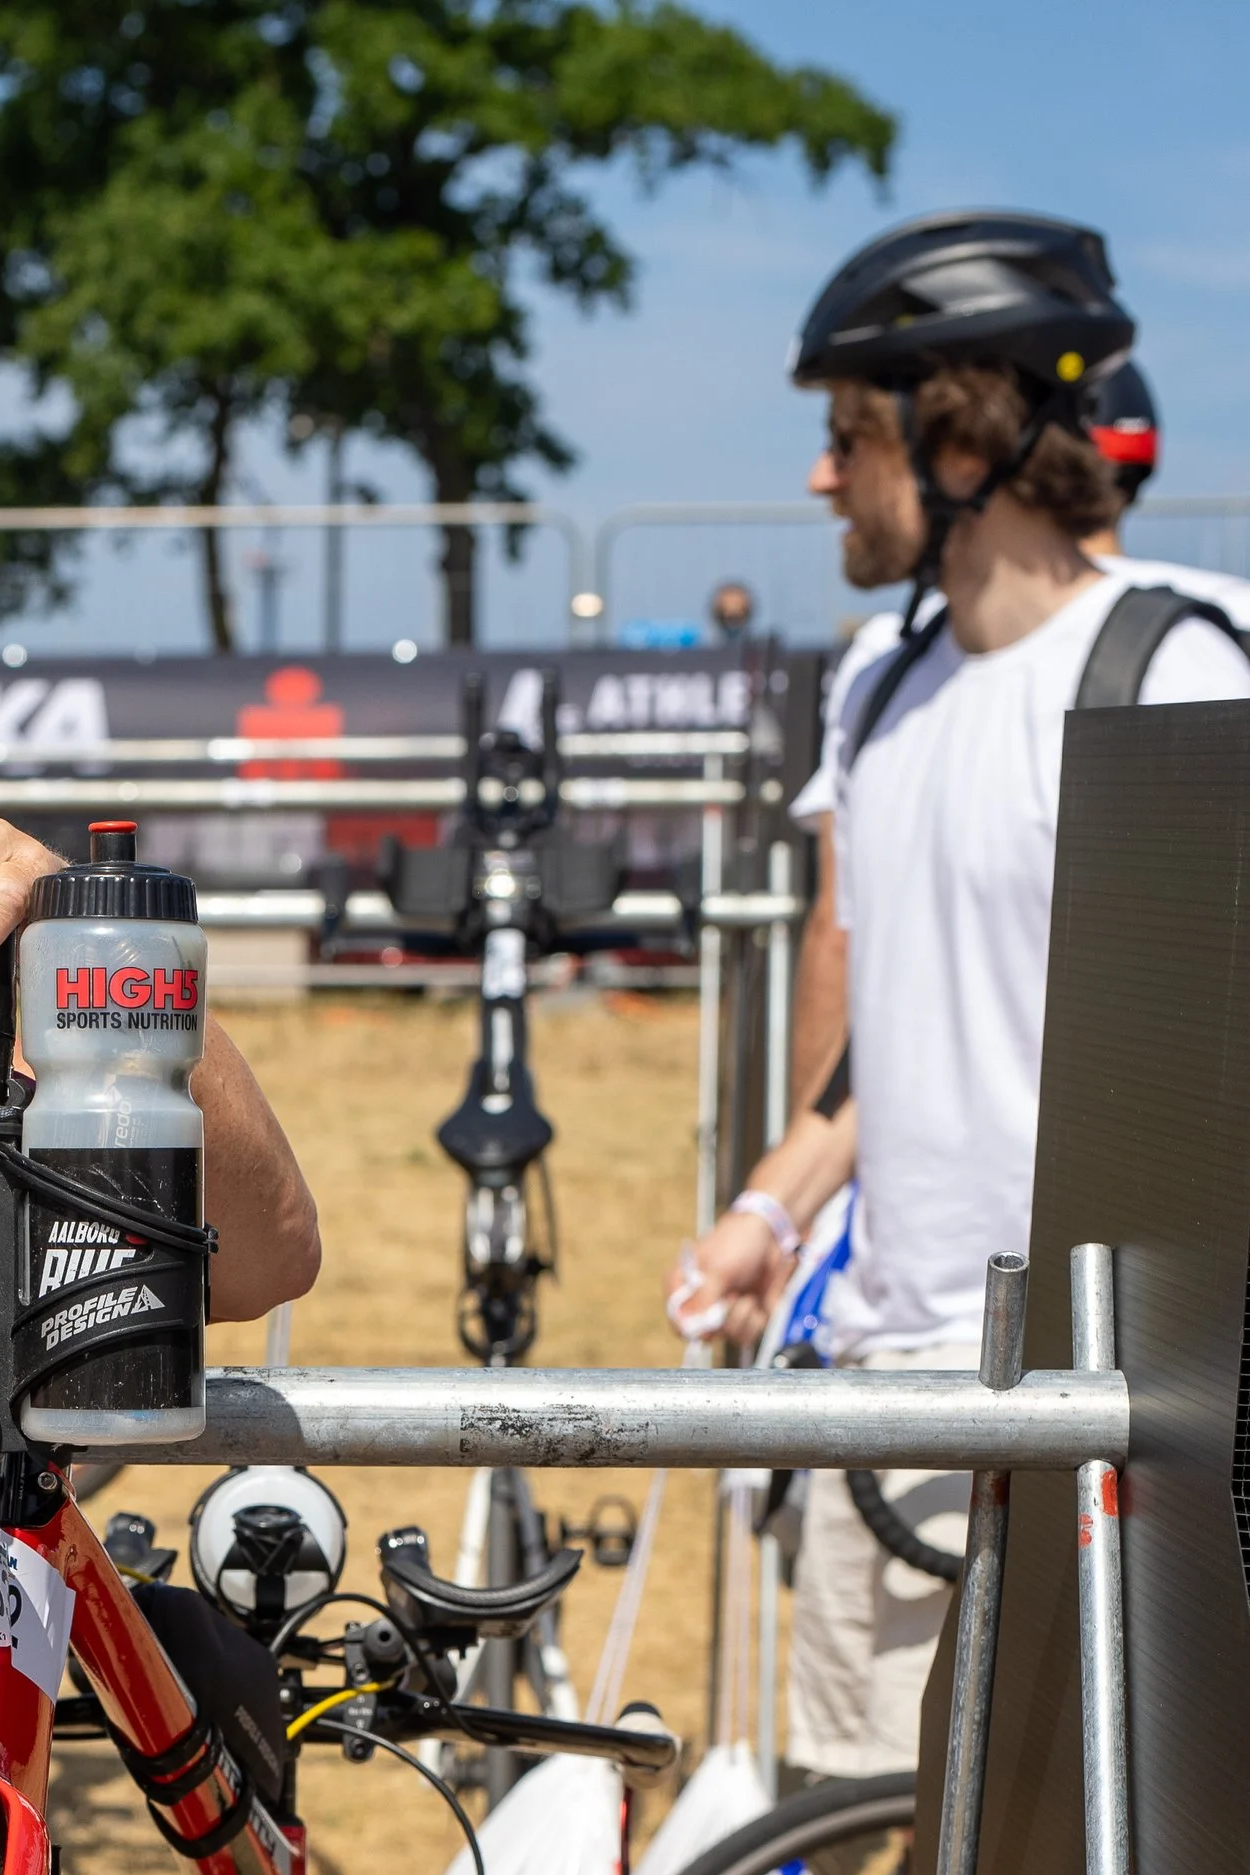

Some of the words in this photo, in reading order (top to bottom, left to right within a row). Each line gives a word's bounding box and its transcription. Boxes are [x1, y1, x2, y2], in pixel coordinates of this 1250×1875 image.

[55, 966, 199, 1011] HIGH5
[56, 1011, 122, 1030] SPORTS
[127, 1012, 198, 1032] NUTRITION
[40, 1286, 138, 1339] PROFILE
[45, 1301, 134, 1351] DESIGN
